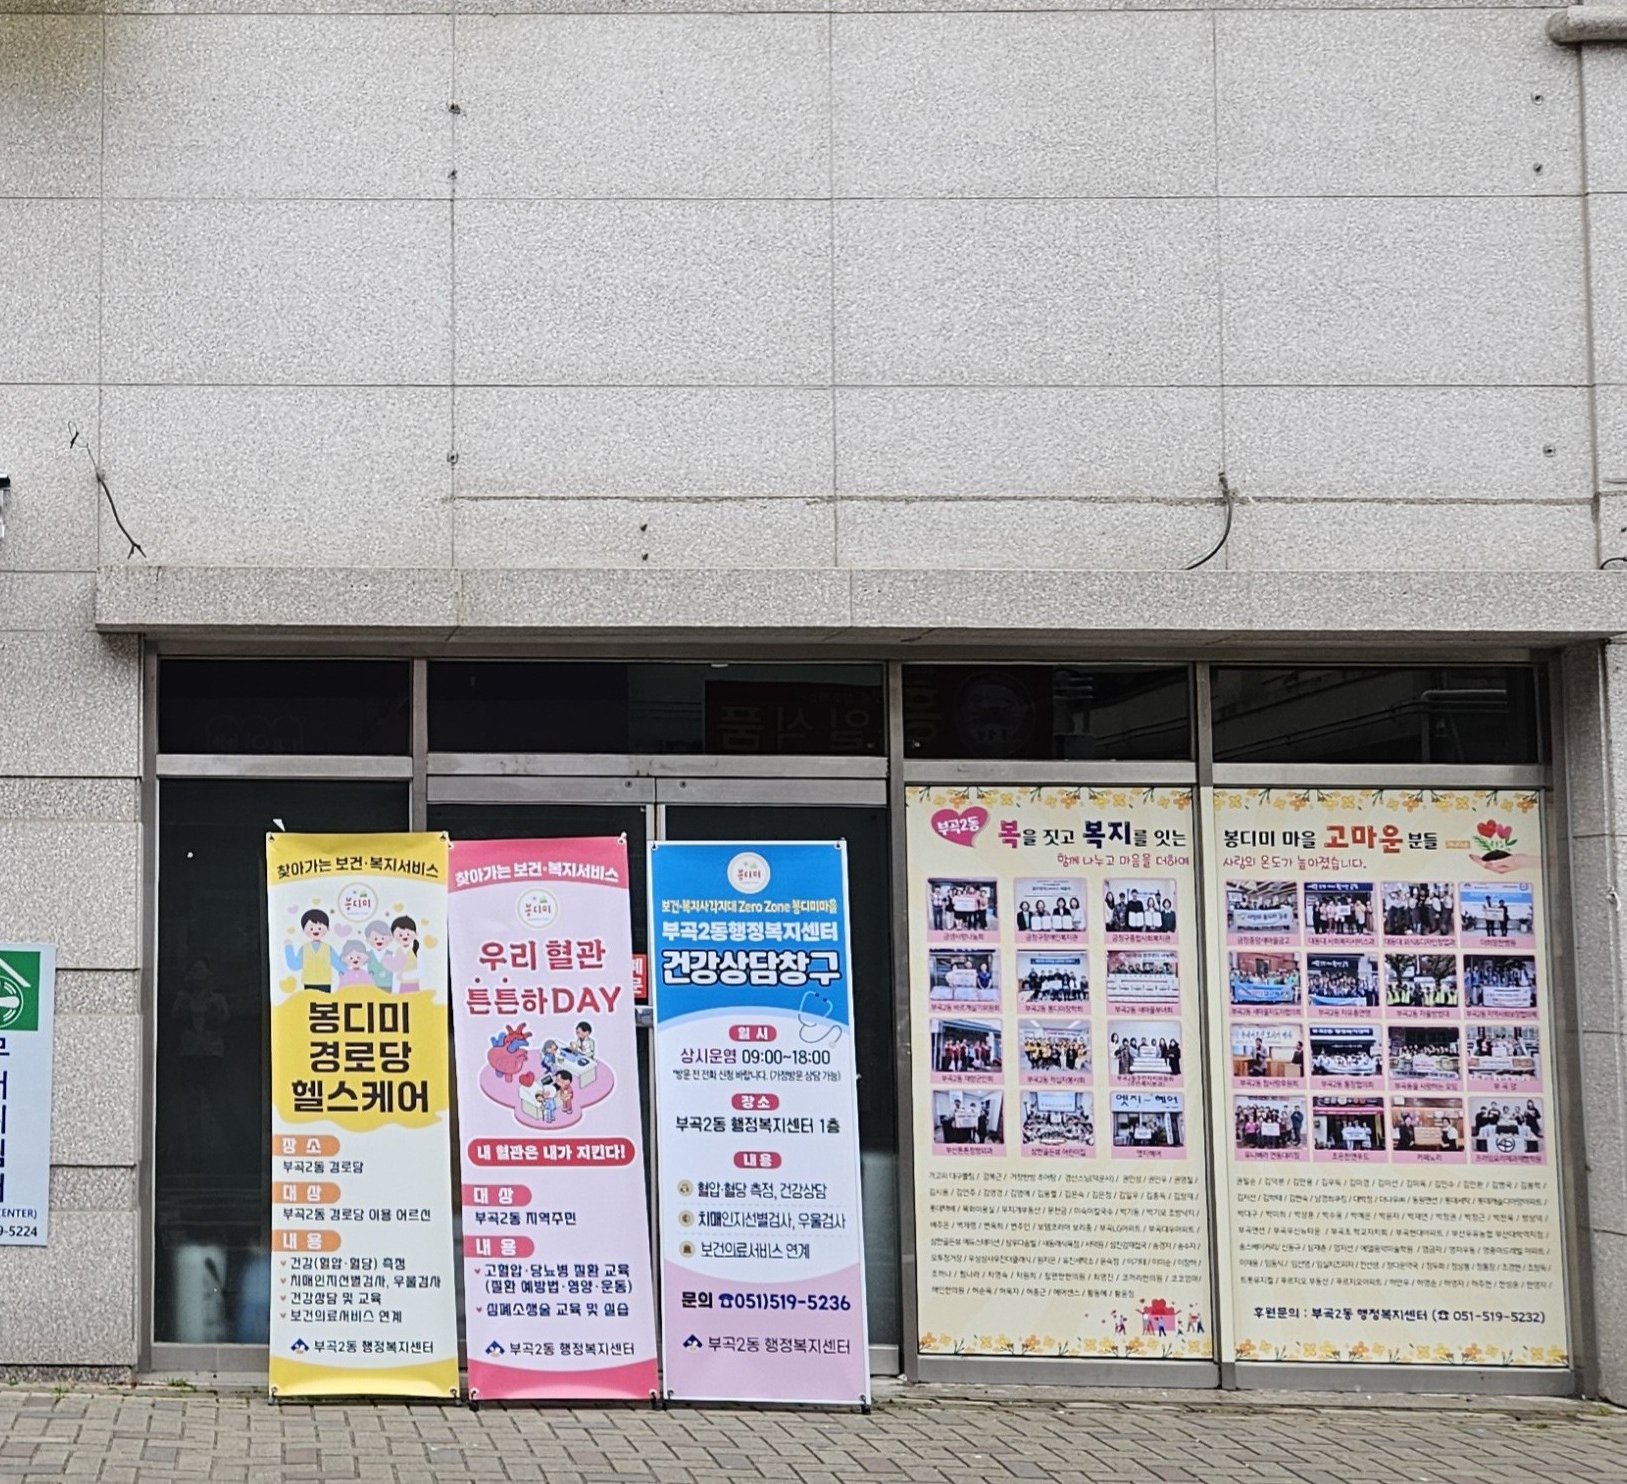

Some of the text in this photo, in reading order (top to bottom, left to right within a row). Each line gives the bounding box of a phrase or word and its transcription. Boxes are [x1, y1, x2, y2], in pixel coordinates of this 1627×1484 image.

[937, 815, 980, 836] 부곡2동
[998, 820, 1186, 849] 복을 짓고 복지를 잇는
[1223, 829, 1275, 849] 봉디미
[1282, 830, 1316, 849] 마을
[1324, 824, 1404, 854] 고마운
[1407, 832, 1438, 850] 분들
[277, 856, 439, 879] 찾아가는 보건·복지서비스
[1057, 853, 1189, 868] 함께 나누고 마음을 더하여
[1222, 857, 1368, 871] 사랑의 온도가 높아졌습니다.
[455, 861, 619, 887] 찾아가는 보건·복지서비스
[345, 898, 371, 911] 봉디미
[738, 900, 762, 913] Zero
[764, 900, 791, 913] Zone
[792, 899, 838, 914] 봉디미마을
[662, 921, 838, 942] 부곡2동행정복지센터
[479, 938, 606, 971] 우리 혈관
[662, 950, 841, 986] 건강상담창구
[466, 986, 622, 1015] 튼튼하DAY
[309, 1002, 409, 1034] 봉디미
[310, 1041, 411, 1073] 경로당
[681, 1048, 831, 1065] 상시운영 09:00~18:00
[692, 1070, 700, 1080] 전
[702, 1070, 716, 1080] 전화
[718, 1070, 734, 1081] 신청
[735, 1070, 768, 1081] 바랍니다.
[770, 1071, 804, 1081] (가정방문
[805, 1071, 821, 1081] 상담
[823, 1071, 841, 1082] 가능)
[292, 1080, 429, 1113] 헬스케어
[676, 1116, 840, 1134] 부곡2동 행정복지센터 1층
[477, 1145, 626, 1161] 내 혈관은 내가 지킨다!
[283, 1161, 364, 1174] 부곡2동 경로당
[750, 1183, 778, 1200] 측정,
[780, 1183, 827, 1199] 건강상담
[283, 1208, 430, 1222] 부곡2동 경로당 이용 어르신
[475, 1212, 576, 1226] 부곡2동 지역주민
[698, 1213, 846, 1230] 치매인지선별검사, 우울검사
[701, 1243, 810, 1259] 보건의료서비스 연계
[383, 1257, 406, 1271] 측정
[574, 1264, 599, 1277] 질환
[604, 1264, 630, 1277] 교육
[291, 1275, 441, 1289] 치매인지선별검사, 우울검사
[485, 1280, 516, 1294] (질환
[291, 1292, 382, 1305] 건강상담 및 교육
[681, 1292, 851, 1311] 문의 051)519-5236
[291, 1310, 402, 1323] 보건의료서비스 연계
[486, 1303, 630, 1317] 심폐소생술 교육 및 실습
[1254, 1307, 1546, 1323] 후원문의 부곡2동 행정복지센터 051-519-5232)
[314, 1340, 434, 1353] 부곡2동 행정복지센터
[509, 1342, 635, 1356] 부곡2동 행정복지센터
[708, 1336, 850, 1354] 부곡2동 행정복지센터
